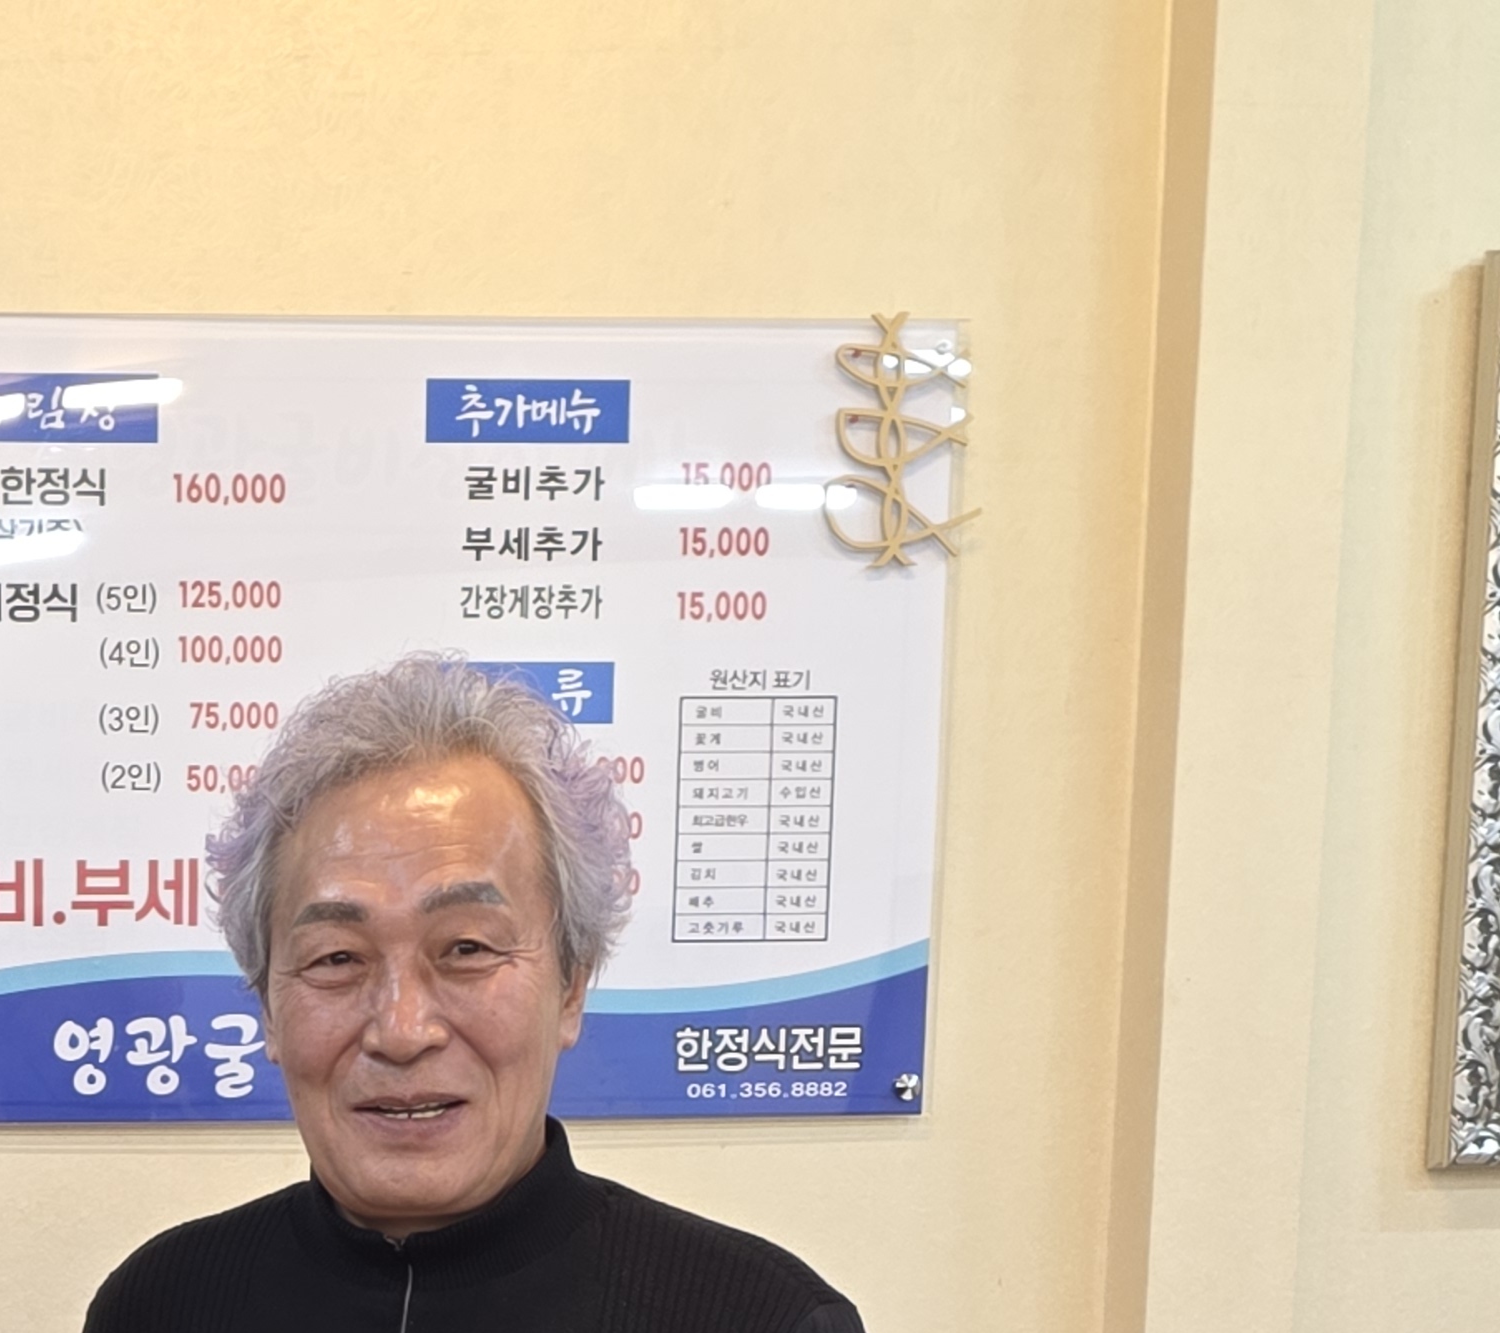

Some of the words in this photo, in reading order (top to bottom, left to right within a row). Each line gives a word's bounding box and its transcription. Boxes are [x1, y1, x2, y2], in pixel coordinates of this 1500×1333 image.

[455, 384, 601, 438] 추가메뉴
[172, 472, 286, 506] 160,000
[464, 466, 605, 502] 굴비추가
[461, 526, 603, 562] 부세추가
[678, 526, 770, 559] 15,000
[96, 583, 157, 614] (5인)
[178, 581, 282, 611] 125,000
[460, 584, 602, 620] 간장게장추가
[676, 591, 767, 623] 15,000
[99, 638, 160, 669] (4인)
[178, 635, 283, 666] 100,000
[709, 669, 767, 691] 원산지
[772, 669, 811, 691] 표기
[99, 704, 160, 735] (3인)
[190, 701, 278, 732] 75,000
[781, 704, 825, 719] 국내산
[780, 731, 824, 746] 국내산
[101, 762, 162, 794] (2인)
[780, 758, 823, 773] 국내산
[778, 813, 820, 828] 국내산
[776, 840, 819, 855] 국내산
[775, 867, 818, 882] 국내산
[775, 894, 817, 909] 국내산
[774, 920, 816, 935] 국내산
[675, 1026, 863, 1073] 한정식전문
[686, 1082, 848, 1100] 061.356.8882
